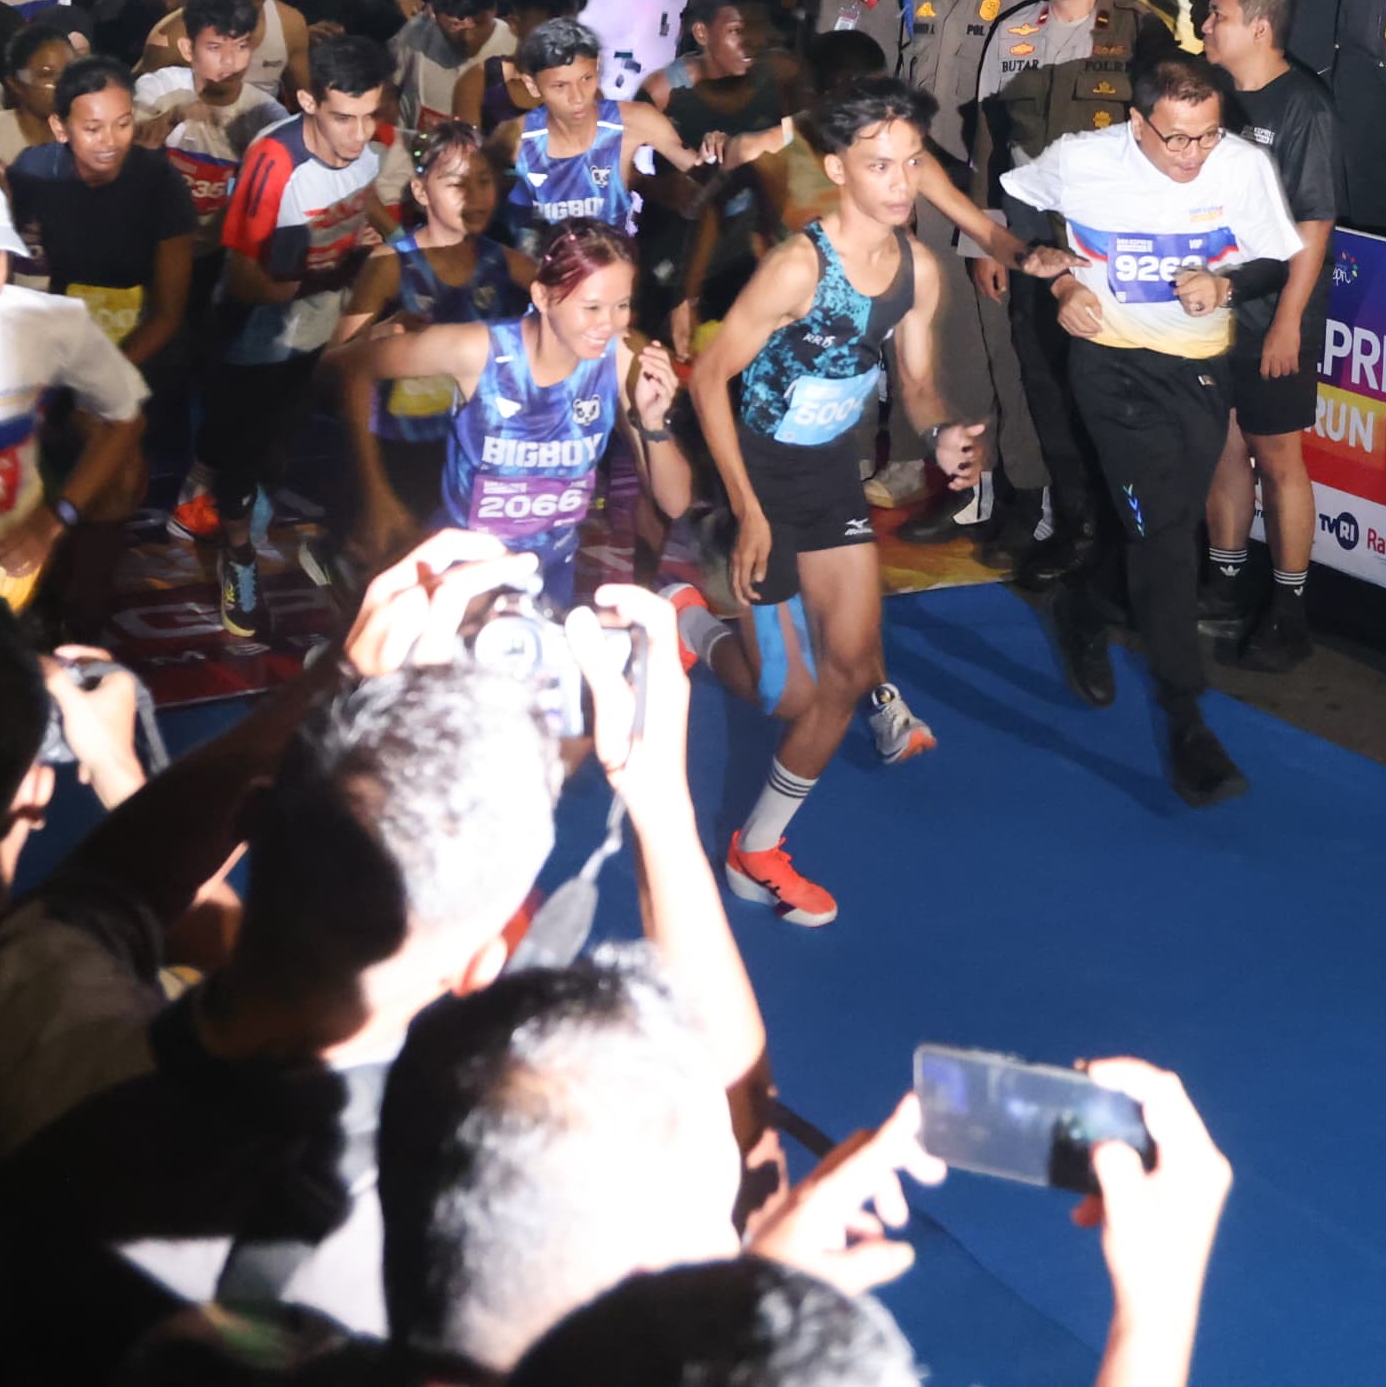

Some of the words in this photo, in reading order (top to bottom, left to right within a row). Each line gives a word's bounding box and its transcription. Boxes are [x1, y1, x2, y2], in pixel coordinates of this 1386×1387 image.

[1002, 59, 1039, 73] BUTAR
[481, 432, 604, 468] BIGBOY
[478, 488, 583, 519] 2066
